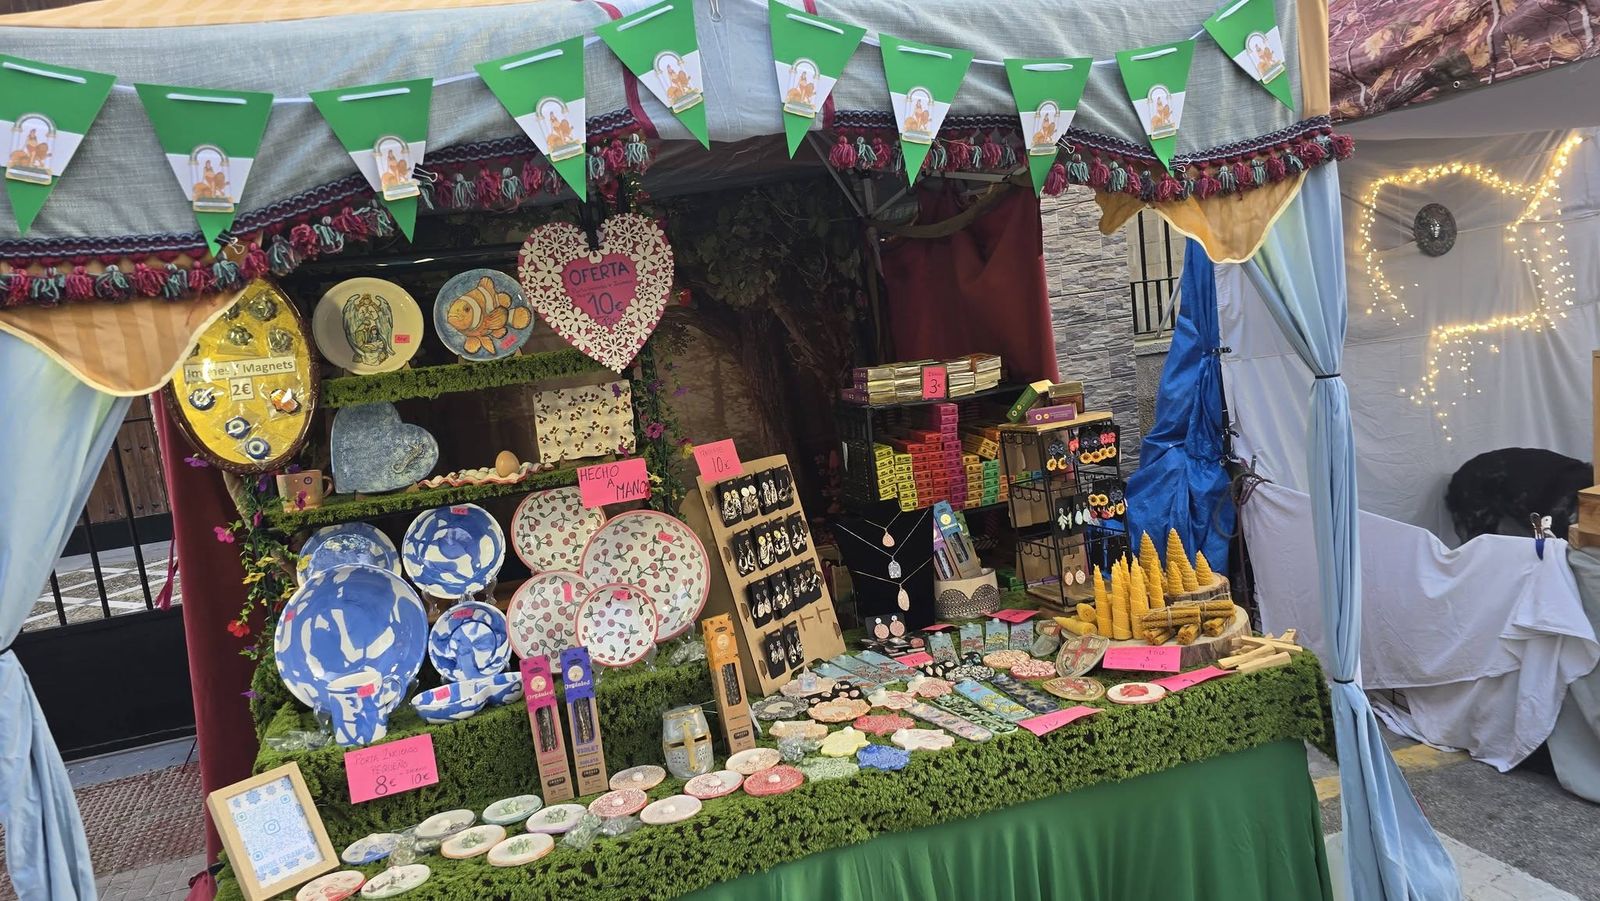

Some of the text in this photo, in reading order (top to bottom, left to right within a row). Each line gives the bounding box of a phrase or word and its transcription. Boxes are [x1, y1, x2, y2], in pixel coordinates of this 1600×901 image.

[569, 262, 630, 285] OFERTA
[588, 292, 624, 315] 10€
[243, 361, 293, 374] Magnets
[232, 384, 251, 396] 2€
[712, 456, 730, 472] 10€
[580, 465, 619, 481] HECHO
[607, 479, 615, 488] A
[616, 479, 648, 500] MANO
[355, 753, 378, 765] PORTA
